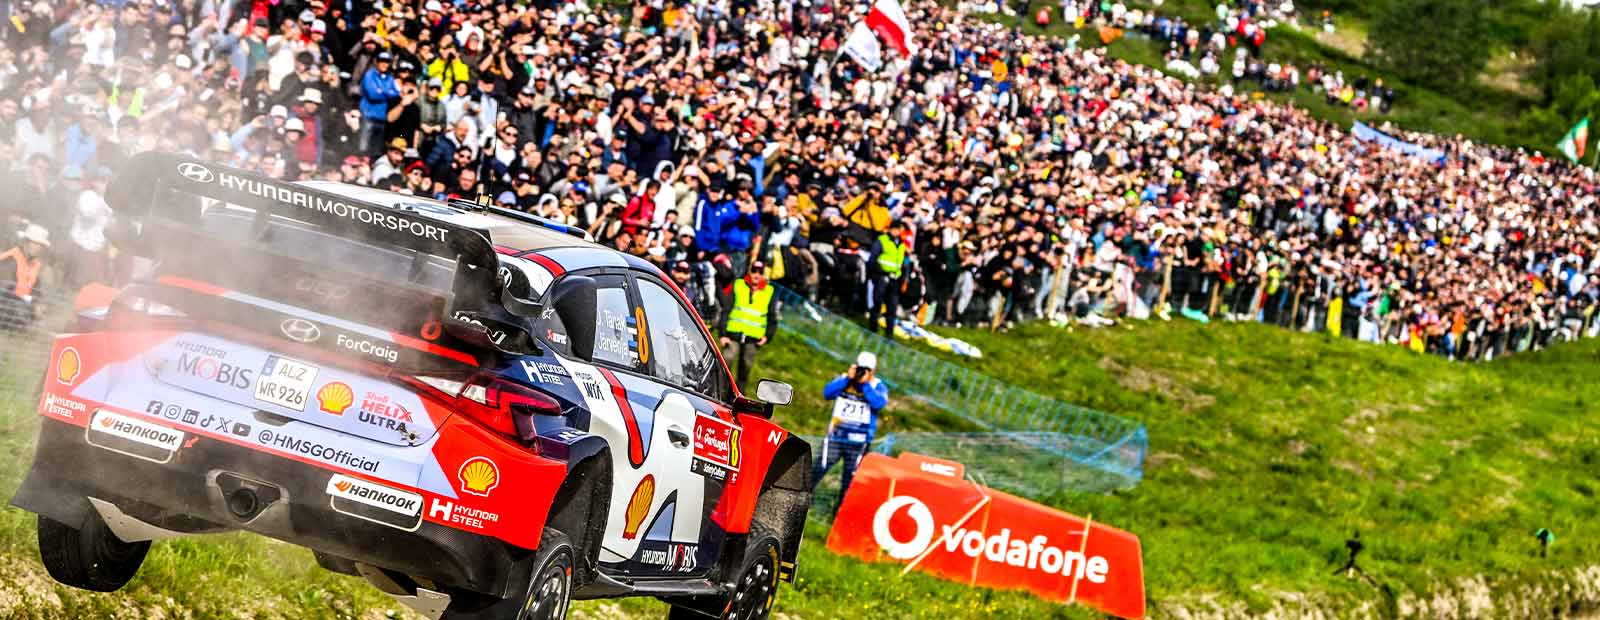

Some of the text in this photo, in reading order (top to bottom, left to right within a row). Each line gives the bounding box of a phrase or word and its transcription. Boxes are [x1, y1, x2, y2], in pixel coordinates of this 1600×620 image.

[220, 172, 448, 242] HYUNDAI MOTORSPORT
[635, 306, 649, 364] 8
[175, 338, 227, 359] HYUNDAI
[337, 334, 398, 363] ForCraig
[176, 352, 253, 389] MOBIS
[278, 363, 307, 382] ALZ
[259, 382, 303, 406] WR 926
[358, 411, 409, 434] ULTRA
[361, 399, 413, 423] HELIX
[257, 429, 381, 473] @HMSGOfficial
[731, 429, 739, 467] 8
[767, 430, 782, 446] N
[452, 514, 484, 529] STEEL
[454, 505, 499, 521] HYUNDAI
[641, 543, 699, 574] HYUNDAI MOBIS
[941, 525, 1109, 583] vodafone
